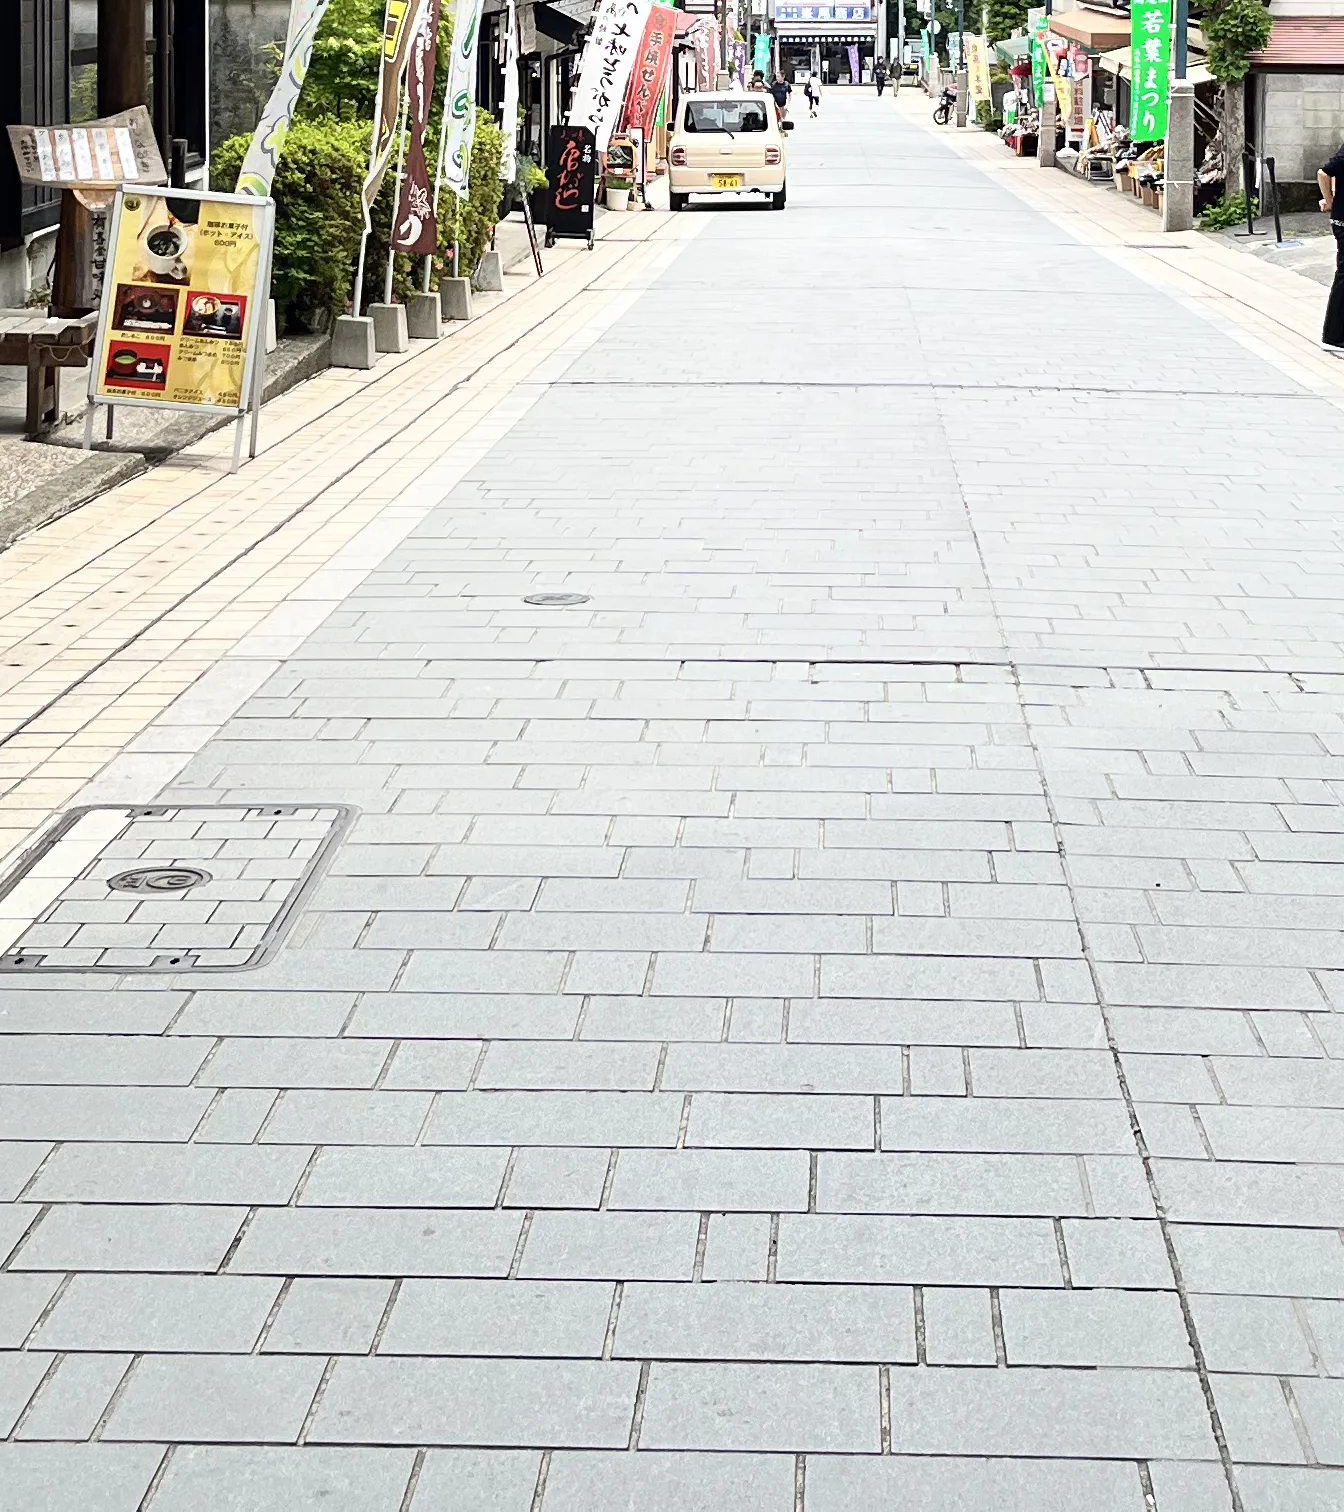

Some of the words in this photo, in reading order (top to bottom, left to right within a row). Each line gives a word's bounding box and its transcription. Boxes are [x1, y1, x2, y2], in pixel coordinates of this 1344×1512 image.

[1141, 9, 1164, 135] 若葉まつり
